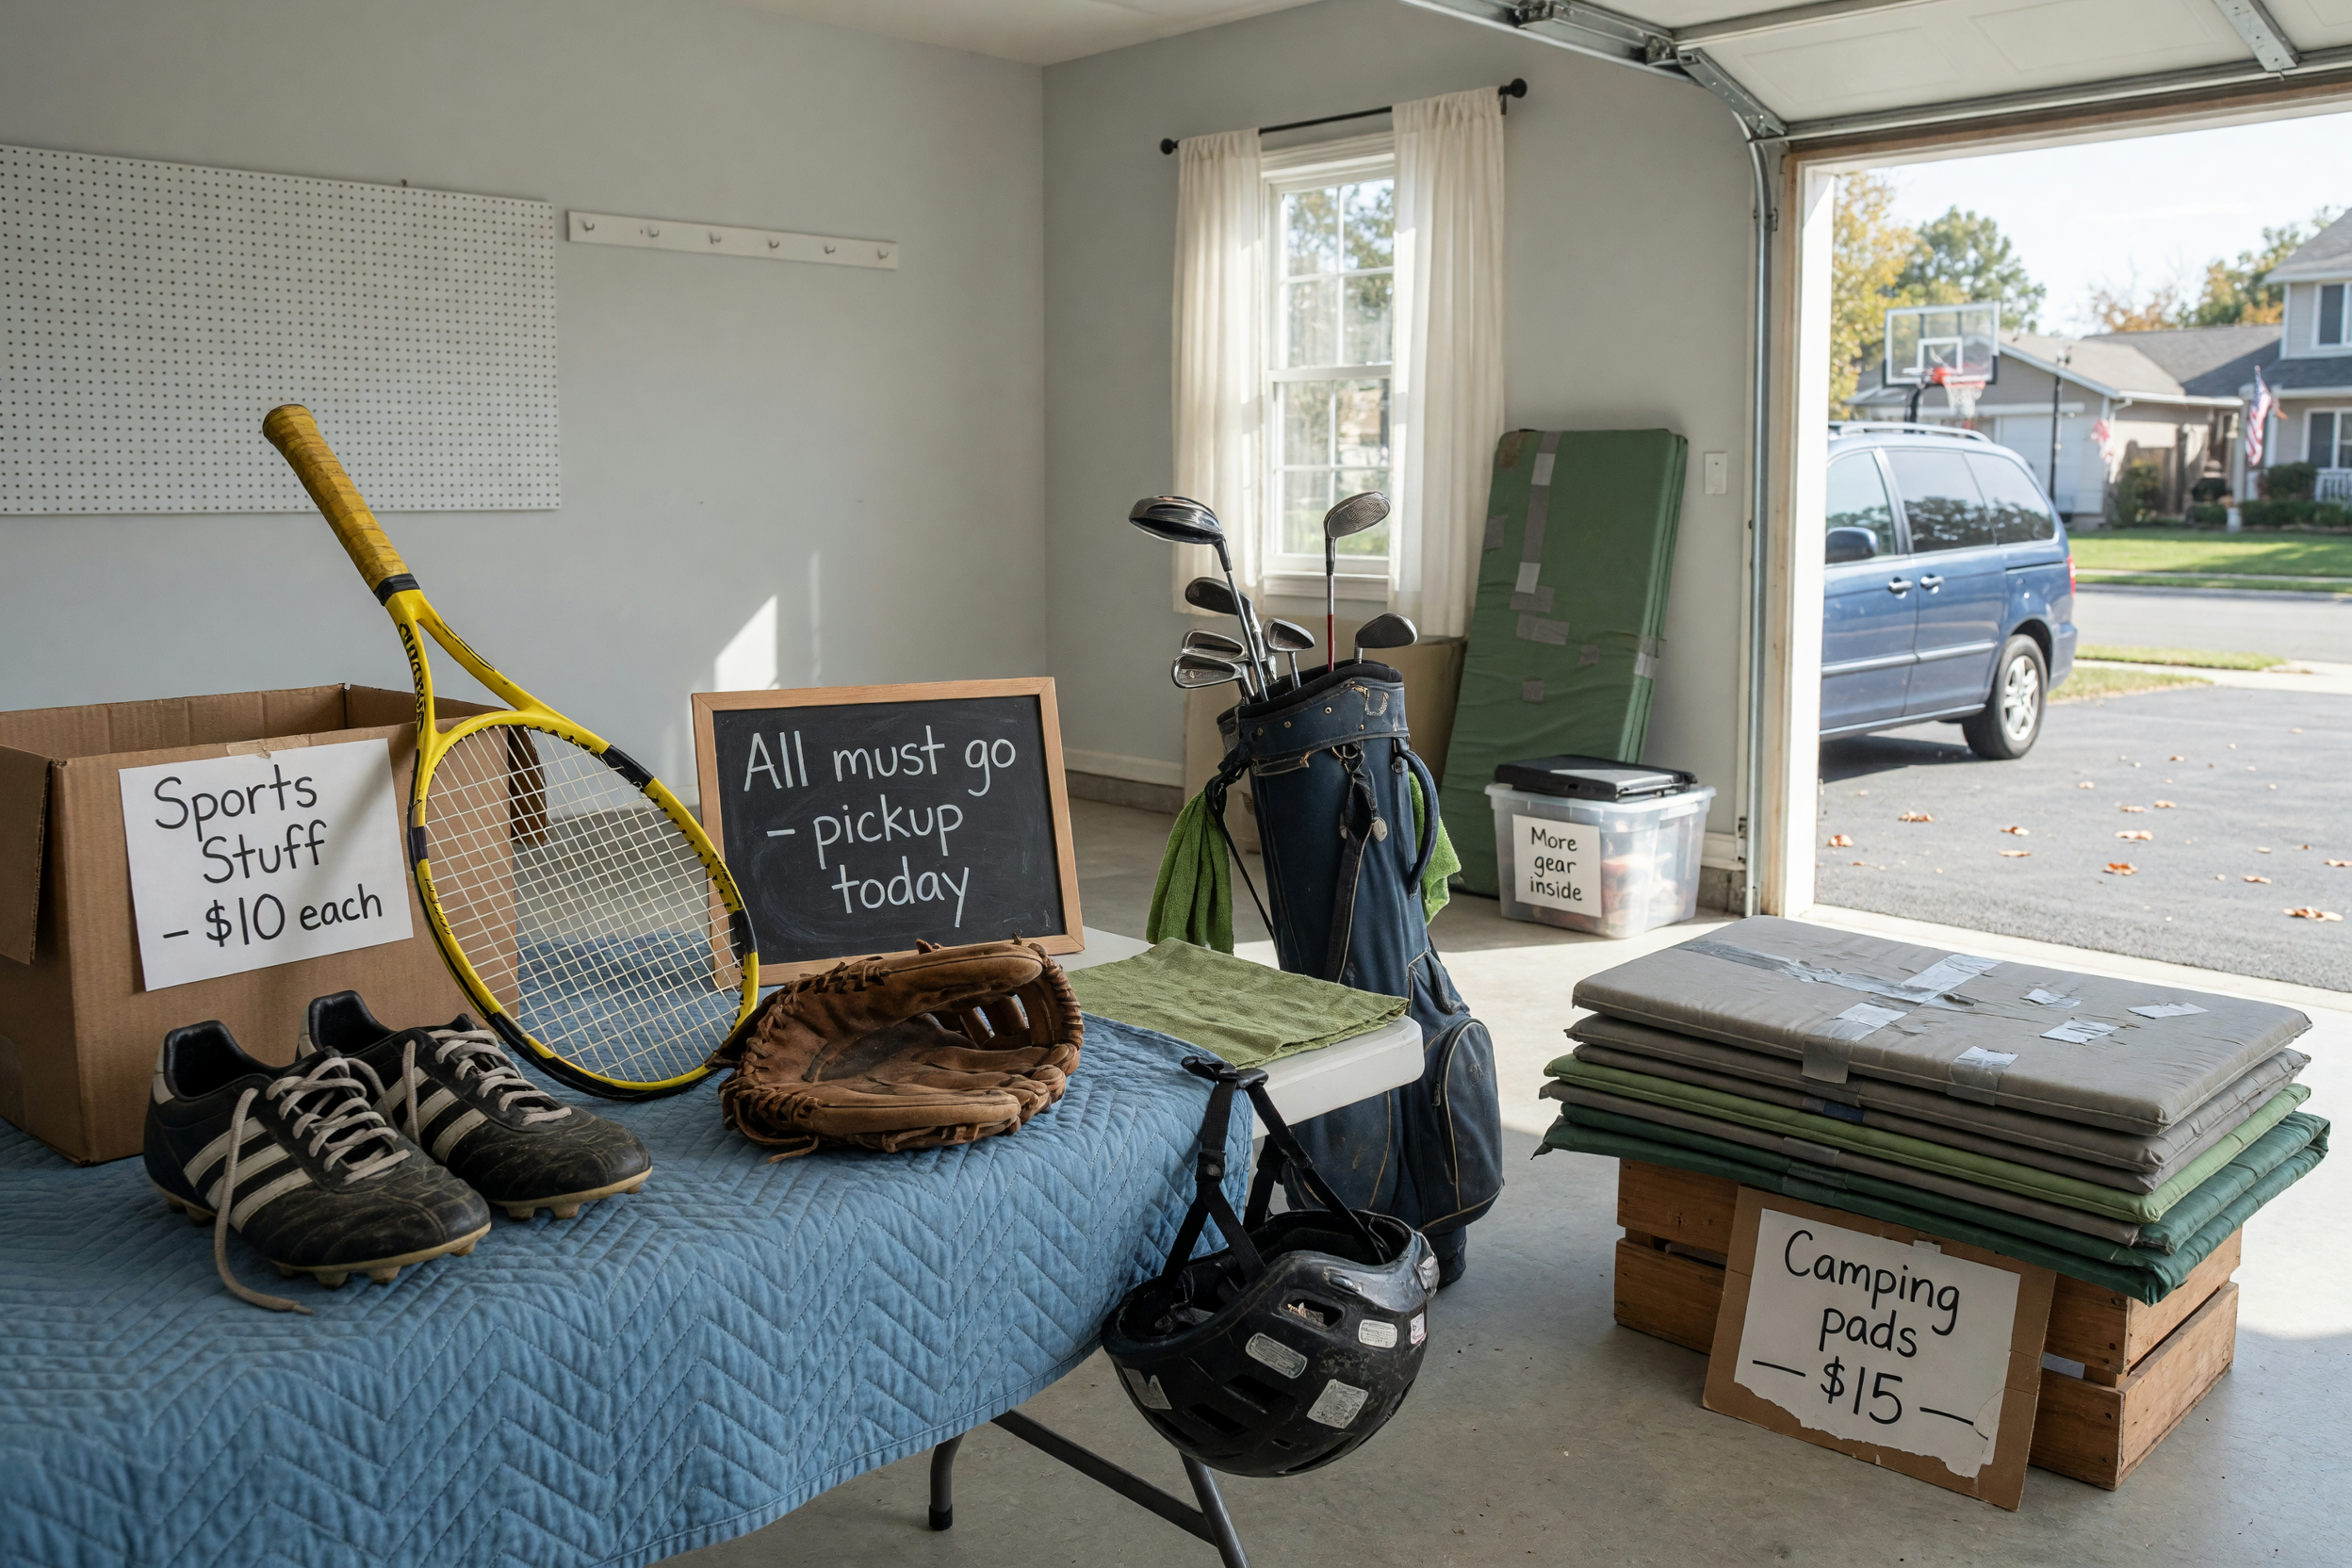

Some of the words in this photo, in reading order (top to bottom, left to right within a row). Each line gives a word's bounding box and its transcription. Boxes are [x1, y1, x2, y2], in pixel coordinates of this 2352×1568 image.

[743, 730, 808, 792] All
[833, 725, 945, 782] must
[965, 739, 1016, 796] go
[154, 764, 318, 841] Sports
[813, 794, 963, 870] pickup
[203, 819, 327, 883] Stuff
[1531, 826, 1577, 852] More
[1534, 856, 1576, 877] gear
[205, 893, 286, 947] $10
[299, 883, 383, 930] each
[831, 856, 969, 928] today
[1530, 876, 1582, 901] inside
[1785, 1230, 1960, 1336] Camping
[1819, 1308, 1918, 1358] pads
[1820, 1356, 1903, 1425] $15
